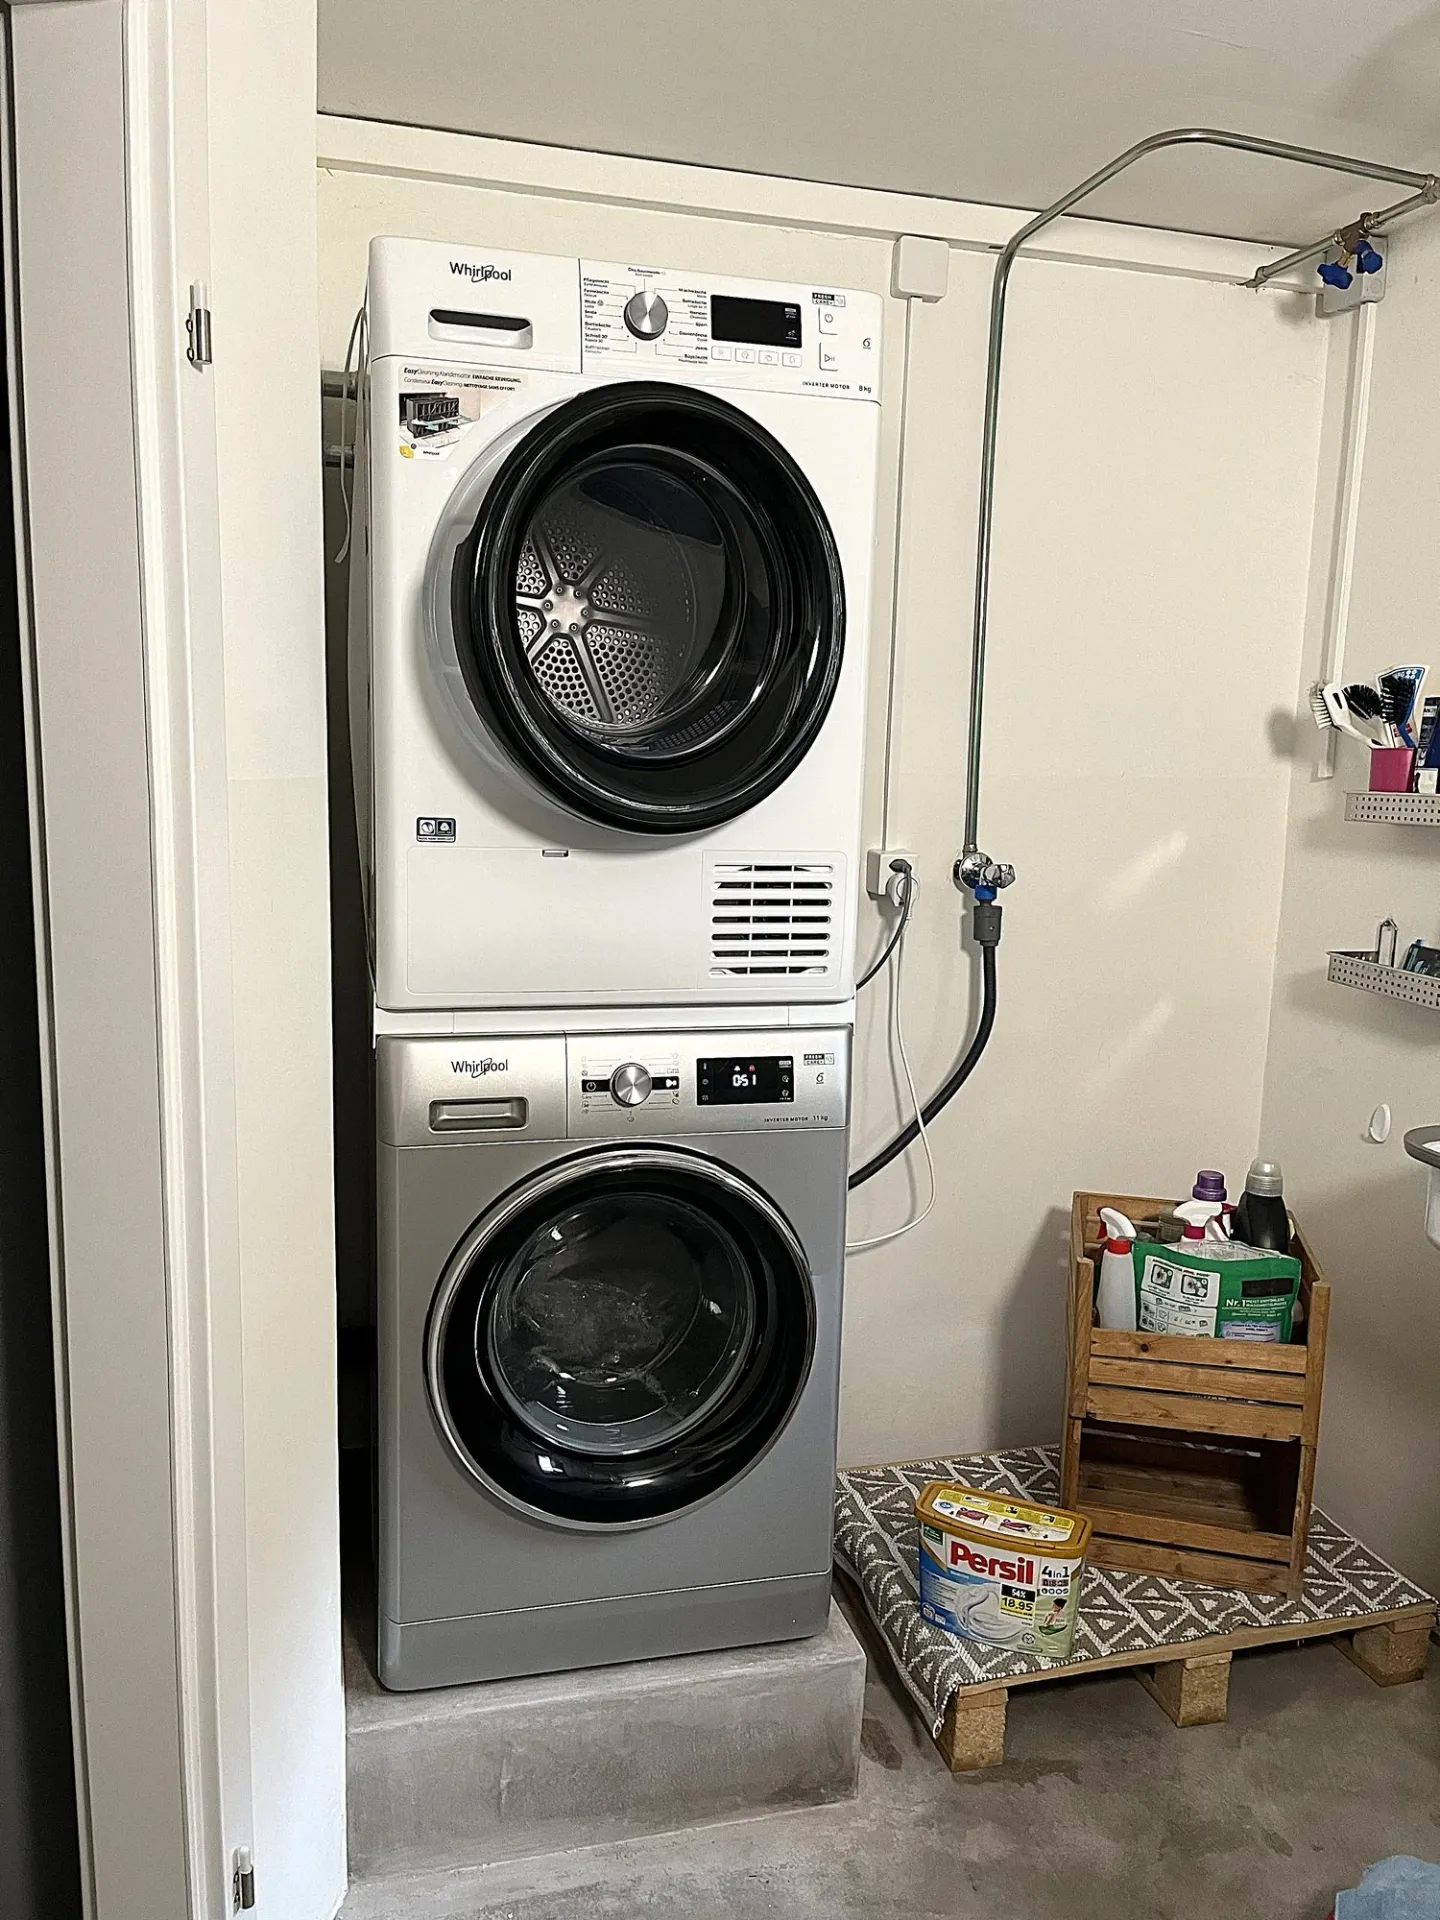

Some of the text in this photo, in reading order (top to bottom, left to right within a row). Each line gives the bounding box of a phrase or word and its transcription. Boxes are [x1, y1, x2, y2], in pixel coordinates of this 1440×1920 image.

[450, 262, 512, 282] Whirlpool
[451, 1058, 508, 1078] Whirlpool
[1226, 1298, 1240, 1307] Nr.
[950, 1540, 1034, 1586] Persil
[1002, 1596, 1034, 1612] 18.95
